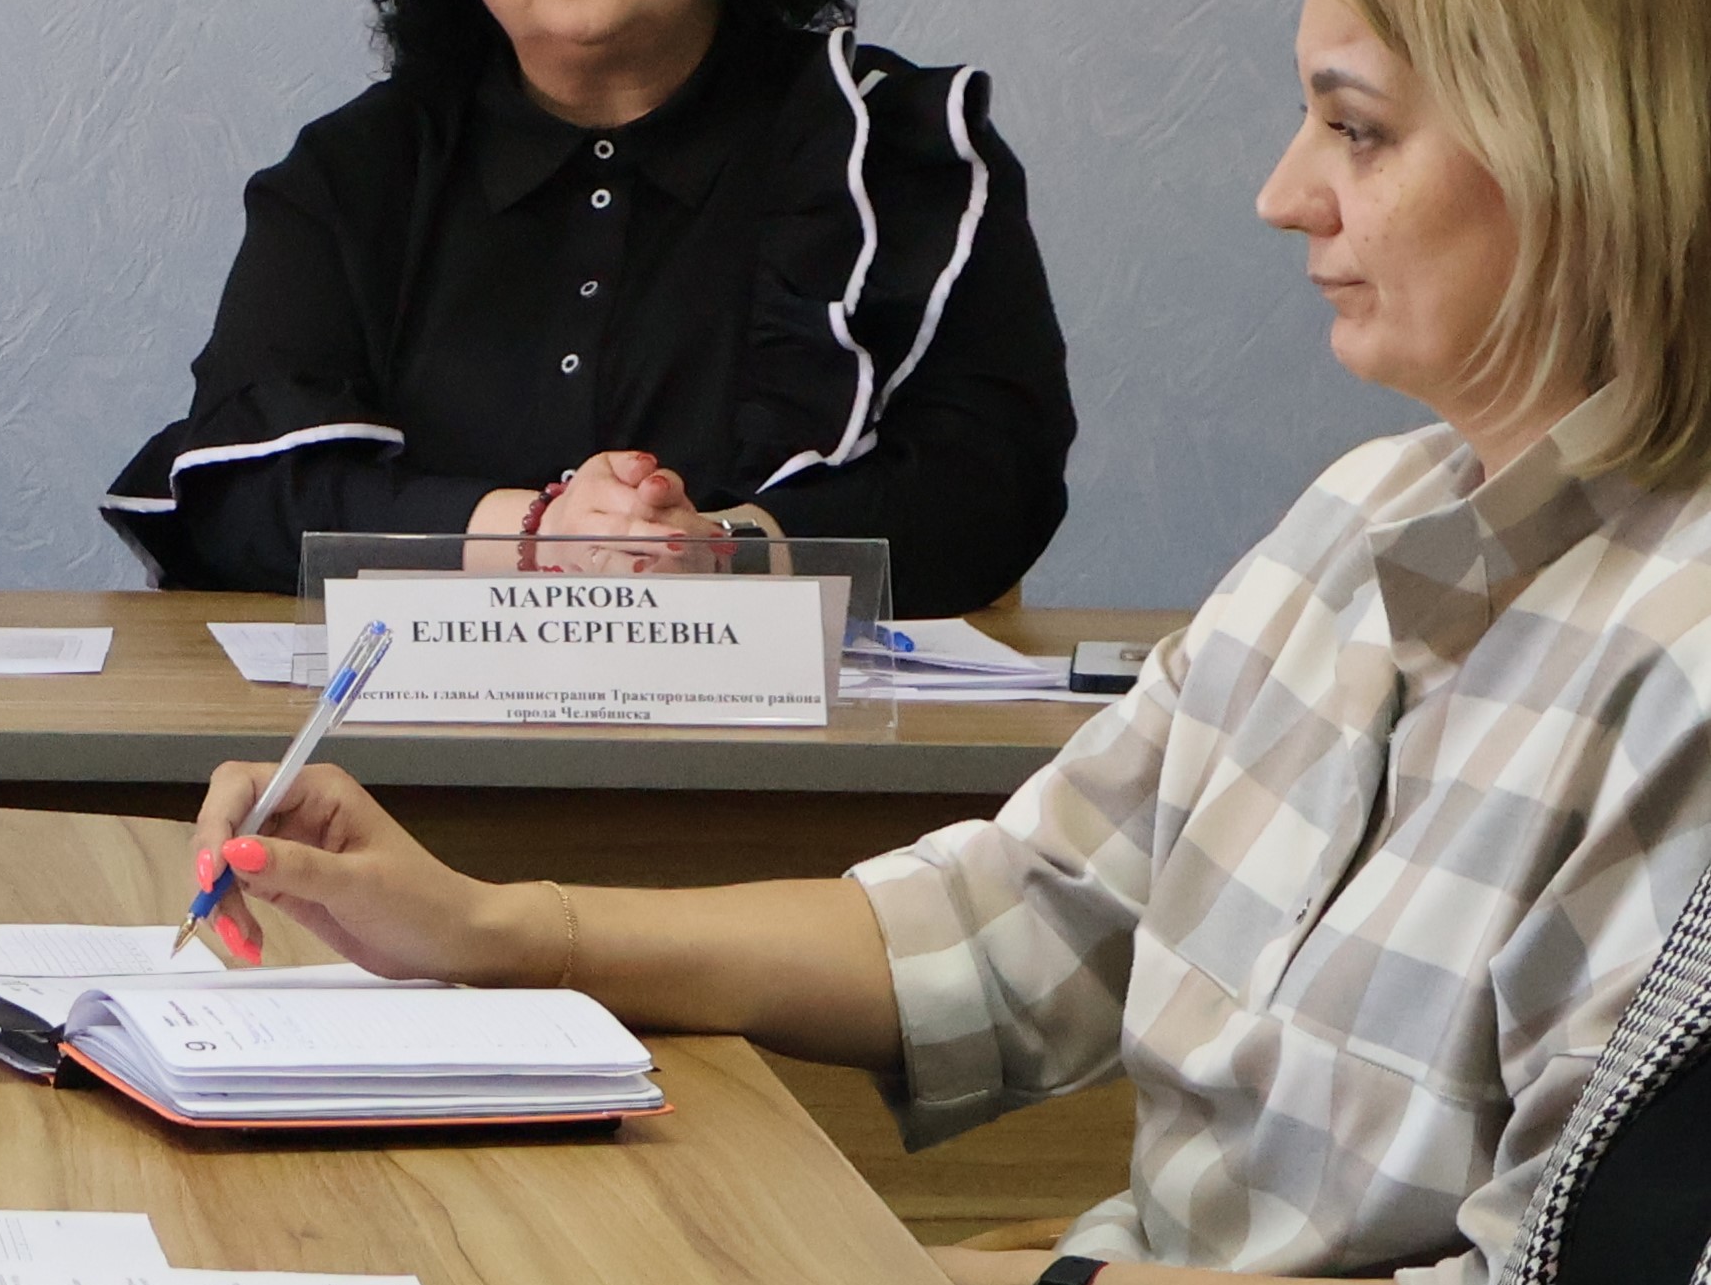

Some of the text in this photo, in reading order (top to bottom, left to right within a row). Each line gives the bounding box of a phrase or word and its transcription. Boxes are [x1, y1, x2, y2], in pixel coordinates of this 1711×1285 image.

[488, 586, 659, 609] МАРКОВА
[411, 620, 740, 646] ЕЛЕНА СЕРГЕЕВНА
